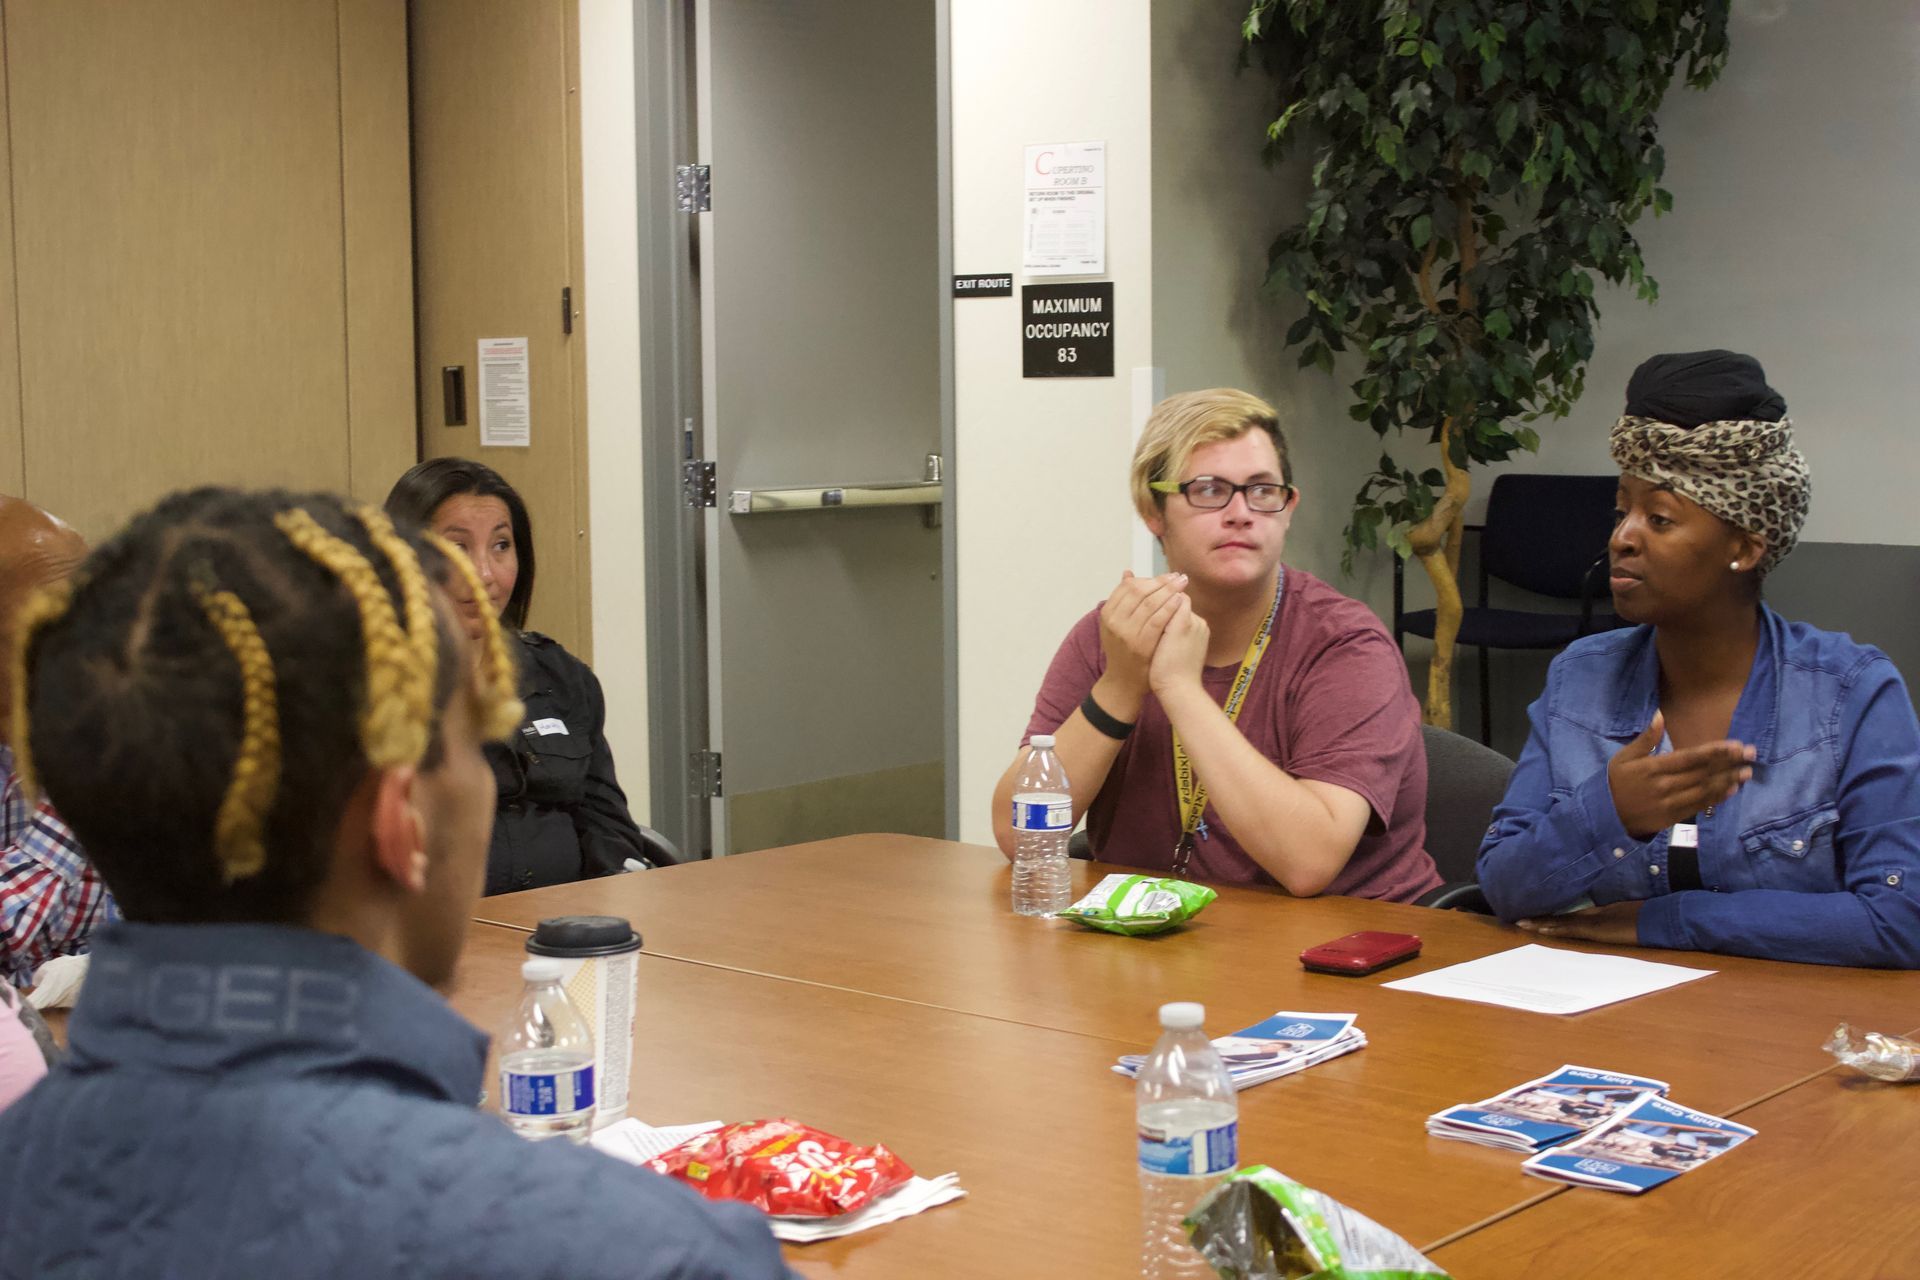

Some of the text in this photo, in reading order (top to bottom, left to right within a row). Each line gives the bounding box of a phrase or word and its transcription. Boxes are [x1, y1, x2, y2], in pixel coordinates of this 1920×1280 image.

[1054, 176, 1088, 186] ROOM B
[956, 278, 1010, 289] EXIT ROUTE
[1032, 298, 1102, 314] MAXIMUM
[1025, 322, 1110, 339] OCCUPANCY
[1057, 347, 1077, 363] 83
[1567, 1070, 1634, 1086] Unity Care
[1651, 1101, 1723, 1129] Unity Care
